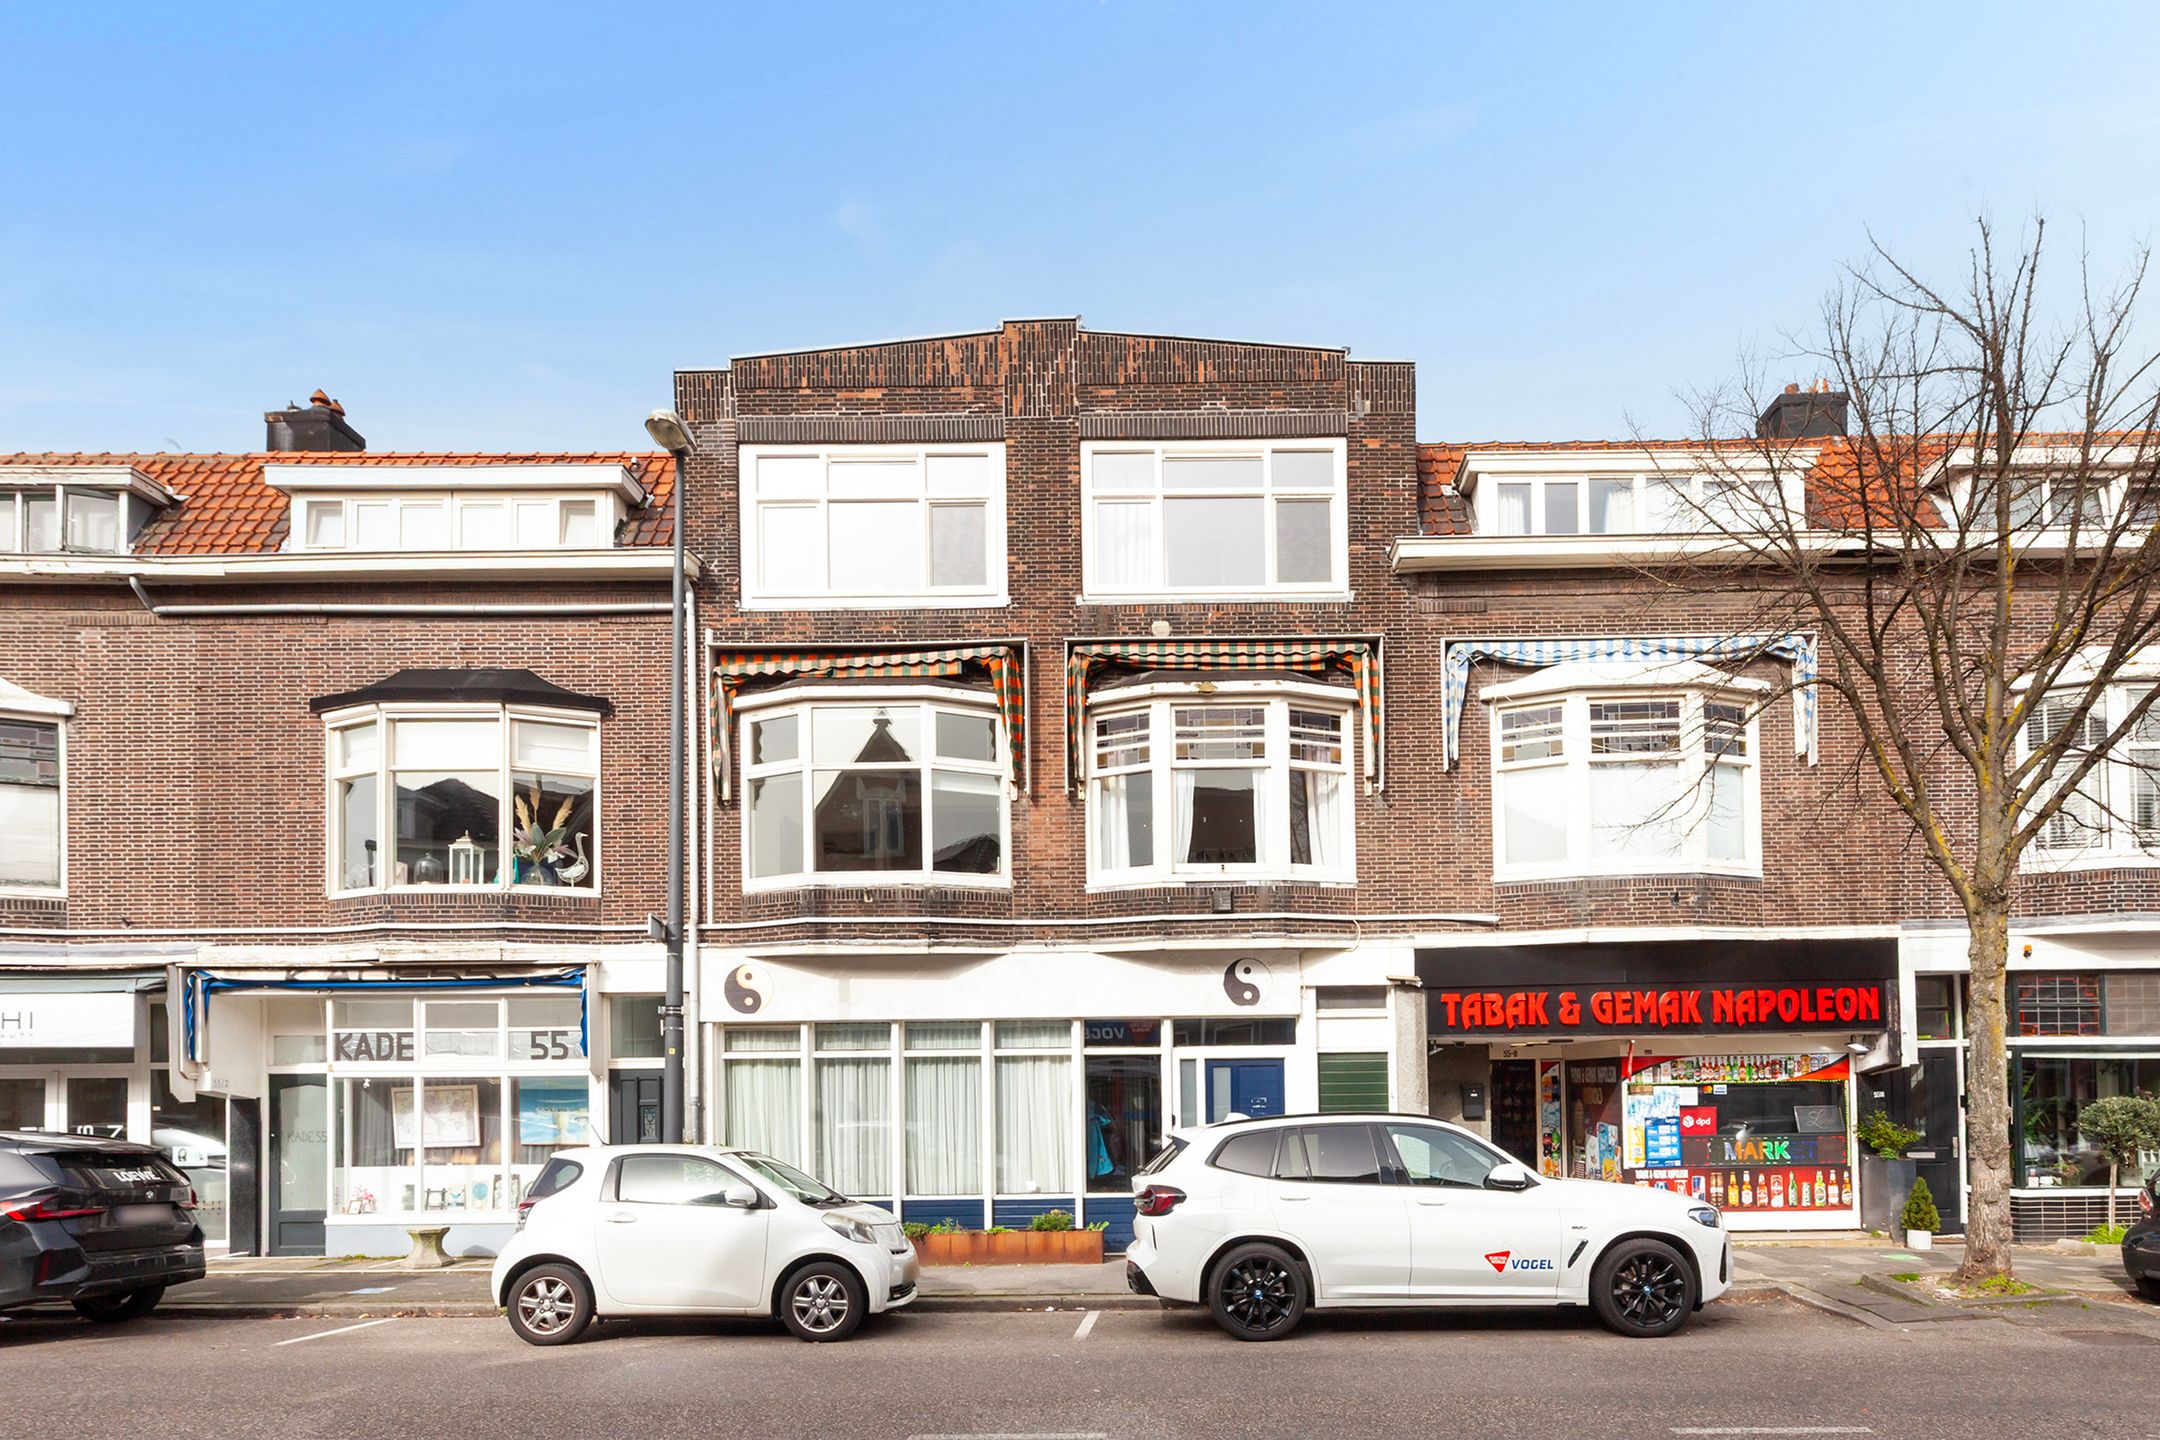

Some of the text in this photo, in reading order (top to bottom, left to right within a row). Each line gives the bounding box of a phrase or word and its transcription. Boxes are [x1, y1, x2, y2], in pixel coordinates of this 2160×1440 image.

[1440, 986, 1880, 1031] TABAK & GEMAK NAPOLEON
[335, 1032, 414, 1061] KADE
[530, 1030, 569, 1060] 55
[1695, 1117, 1712, 1127] dpd
[1511, 1259, 1554, 1270] VOGEL
